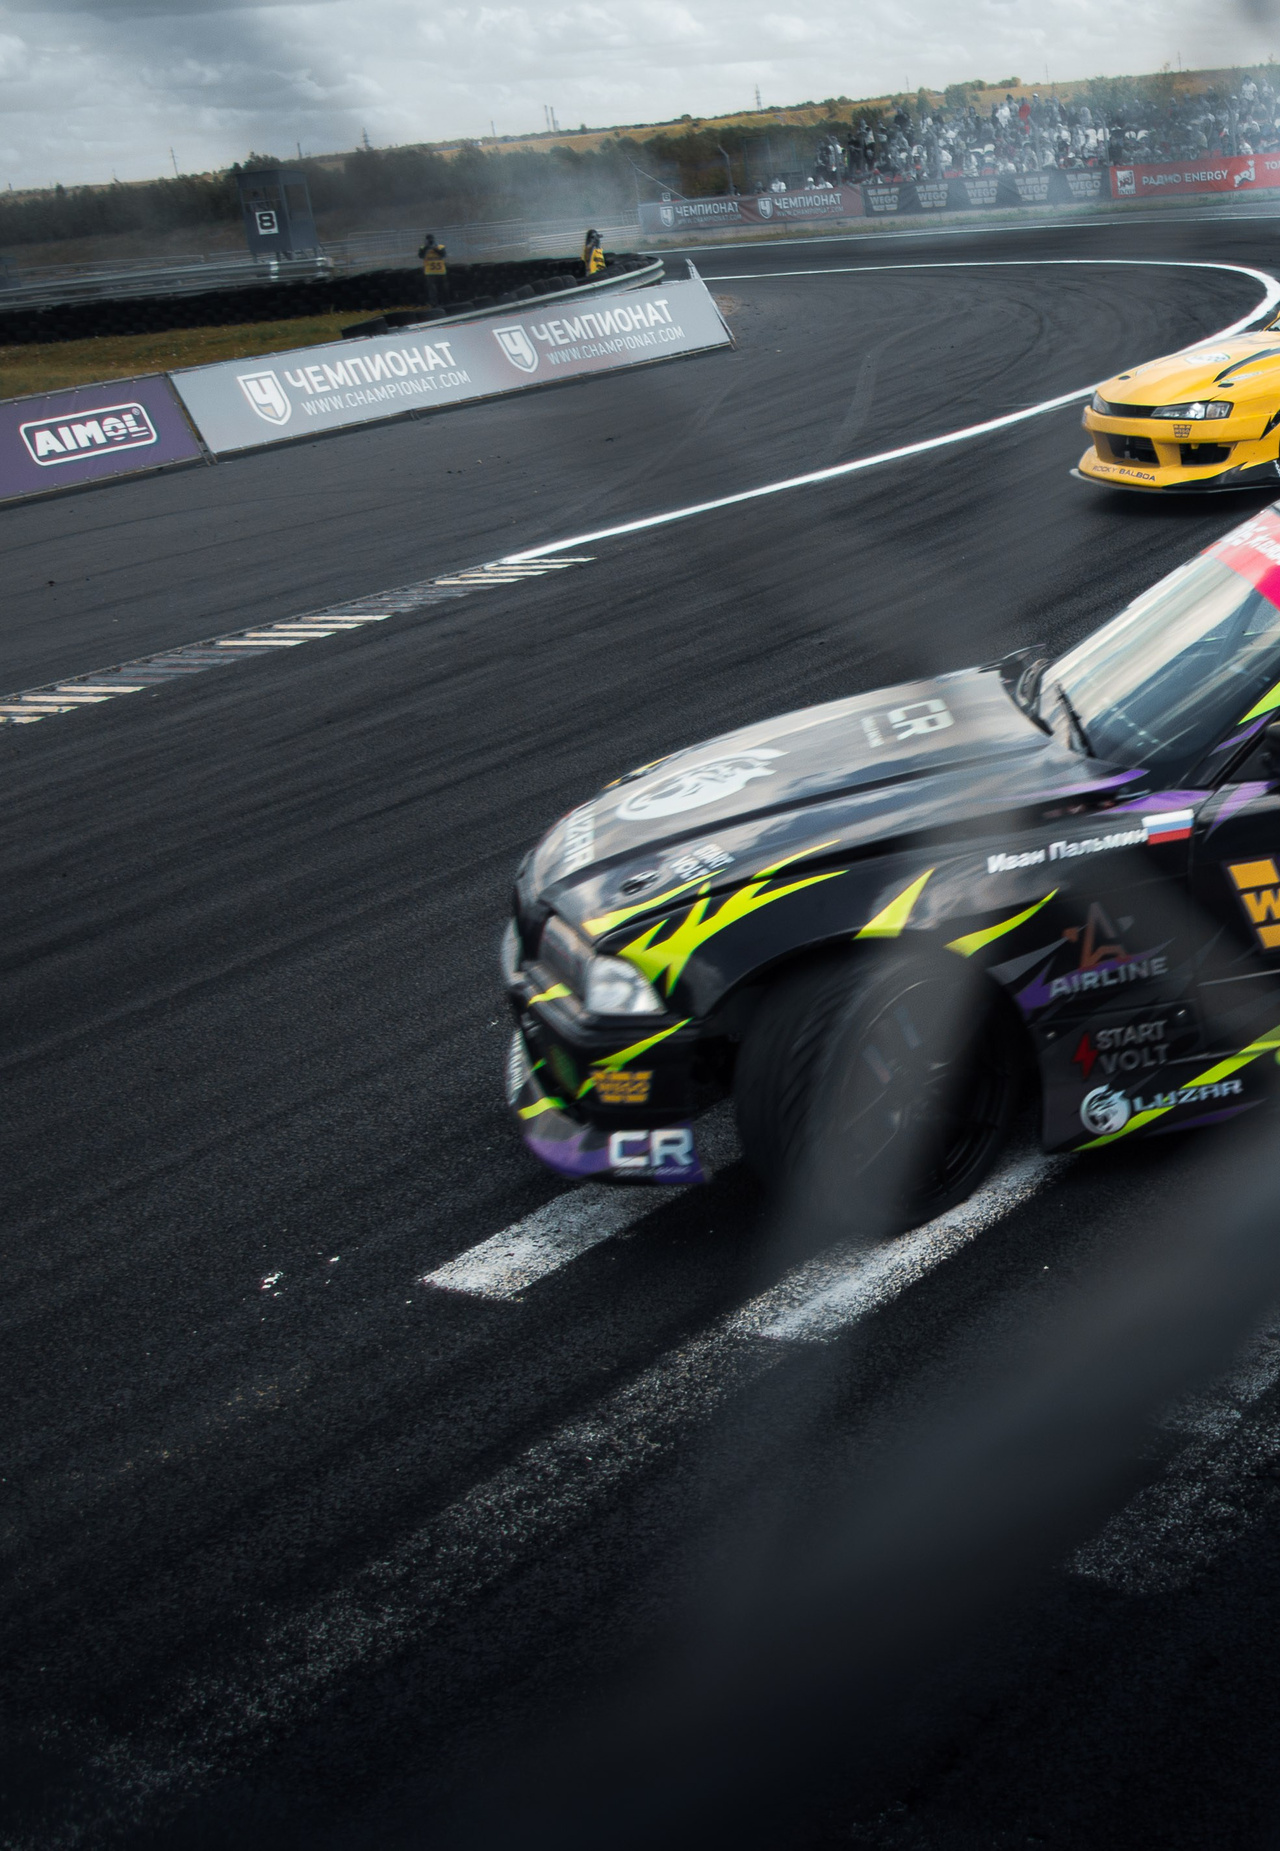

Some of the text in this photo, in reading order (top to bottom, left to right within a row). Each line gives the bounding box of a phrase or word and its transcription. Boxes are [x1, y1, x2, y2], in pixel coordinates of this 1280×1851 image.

[1017, 184, 1048, 195] WEGO
[1069, 180, 1100, 191] WEGO
[1142, 169, 1229, 186] РАДИО ENERGY
[775, 193, 842, 210] ЧЕМПИОНАТ
[870, 195, 899, 205] WEGO
[918, 191, 948, 201] WEGO
[967, 188, 997, 198] WEGO
[258, 213, 275, 231] 8
[675, 201, 740, 217] ЧЕМПИОНАТ
[531, 300, 673, 346] ЧЕМПИОНАТ
[546, 326, 686, 365] WWW.CHAMPIONAT.COM
[285, 342, 457, 395] ЧЕМПИОНАТ
[301, 370, 472, 416] WWW.CHAMPIONAT.COM
[34, 413, 149, 457] AIMOL
[1092, 465, 1156, 482] ROCKY BALBOA
[887, 699, 955, 740] CR
[987, 849, 1045, 874] Иван
[1049, 955, 1167, 998] AIRLINE
[1096, 1020, 1167, 1051] START
[1101, 1043, 1169, 1075] VOLT
[1133, 1079, 1242, 1113] LUZAR
[609, 1129, 693, 1168] CR
